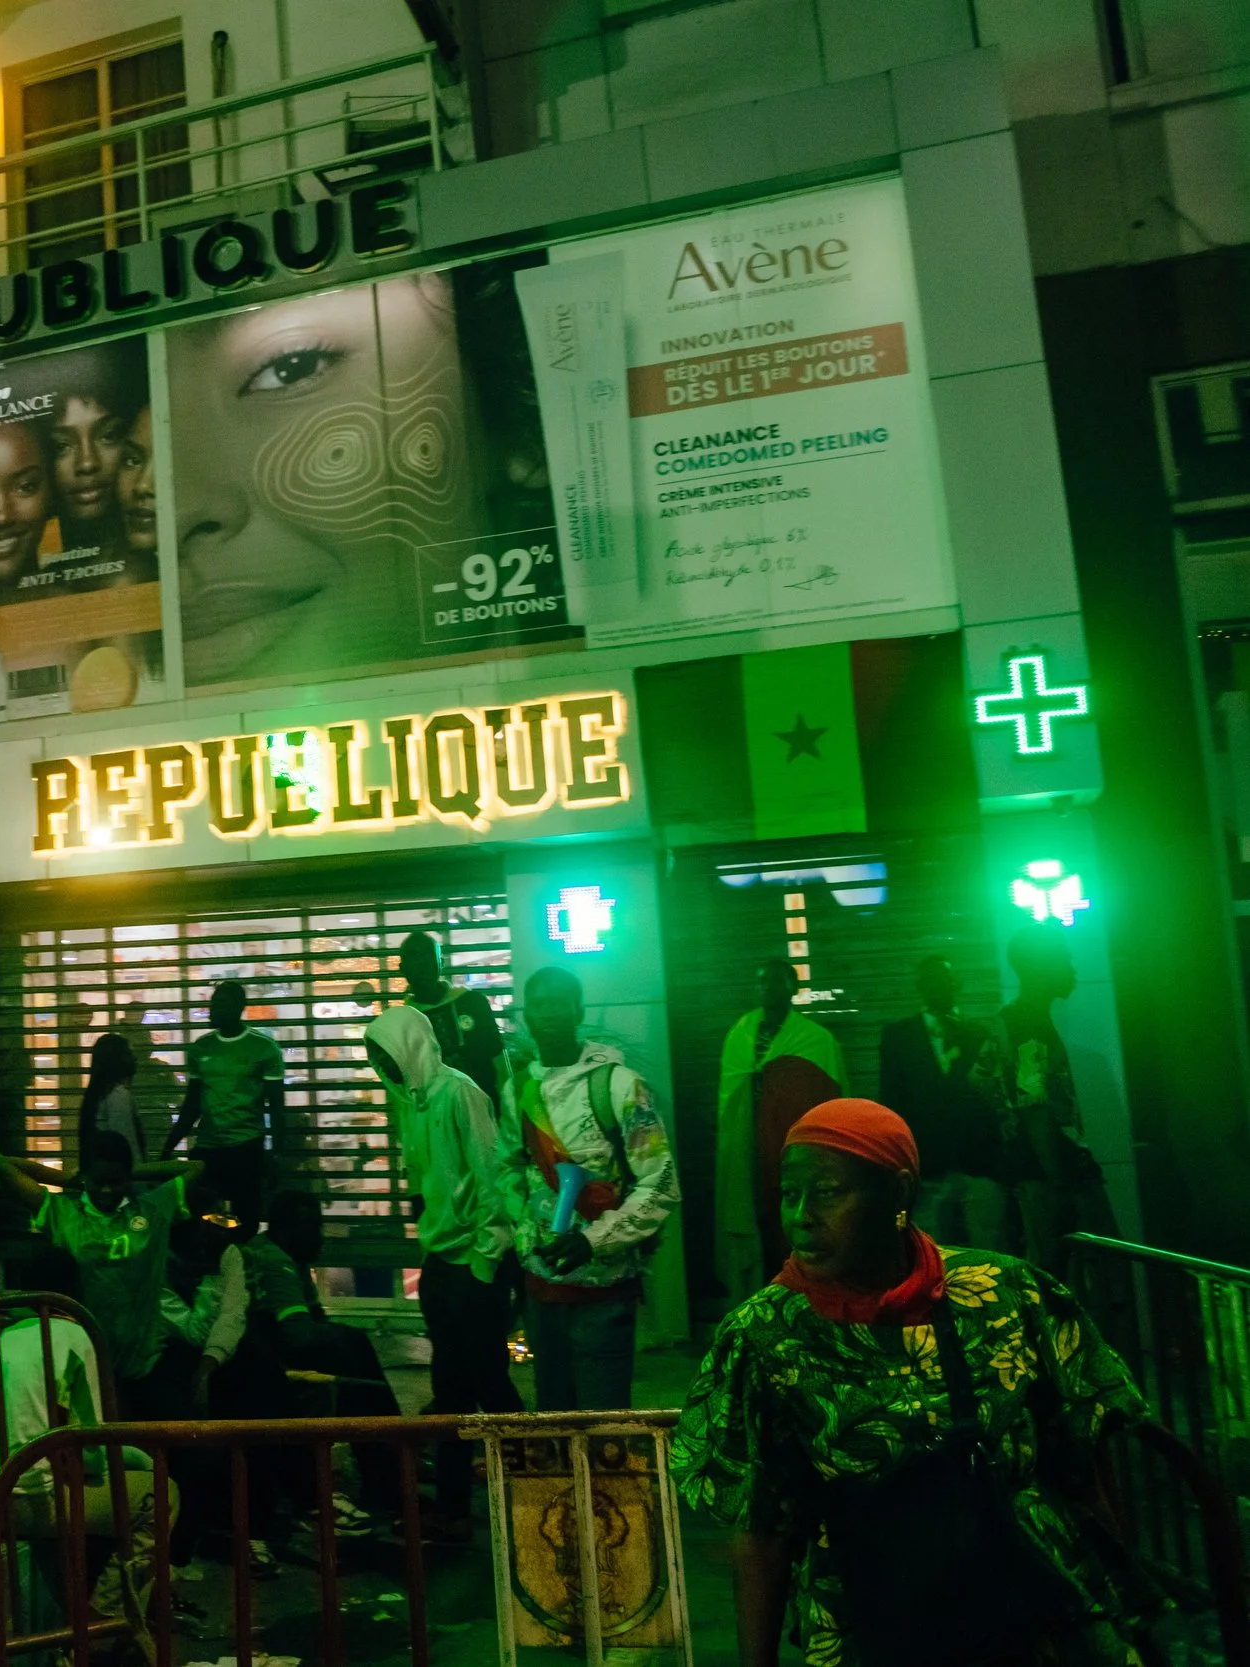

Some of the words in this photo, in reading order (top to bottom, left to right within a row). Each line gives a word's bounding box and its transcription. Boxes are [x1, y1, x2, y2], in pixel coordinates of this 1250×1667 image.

[710, 232, 745, 248] EAU
[753, 212, 846, 240] THERMALE
[667, 238, 850, 301] Avène
[660, 319, 796, 355] INNOVATION
[663, 357, 733, 383] RÉDUIT
[736, 352, 770, 370] LES
[773, 335, 875, 364] BOUTONS
[666, 376, 719, 406] DÈS
[725, 373, 755, 396] LE
[654, 423, 781, 457] CLEANANCE
[655, 441, 796, 476] COMEDOMED
[801, 427, 890, 454] PEELING
[657, 486, 708, 504] CRÈME
[709, 475, 783, 497] INTENSIVE
[659, 487, 812, 519] ANTI-IMPERFECTIONS
[564, 483, 583, 562] CLEANANCE
[17, 560, 126, 589] ANTI-TACHES
[432, 544, 555, 602] -92%
[434, 608, 460, 626] DE
[461, 596, 558, 623] BOUTONS
[32, 692, 629, 858] REPUBLIQUE
